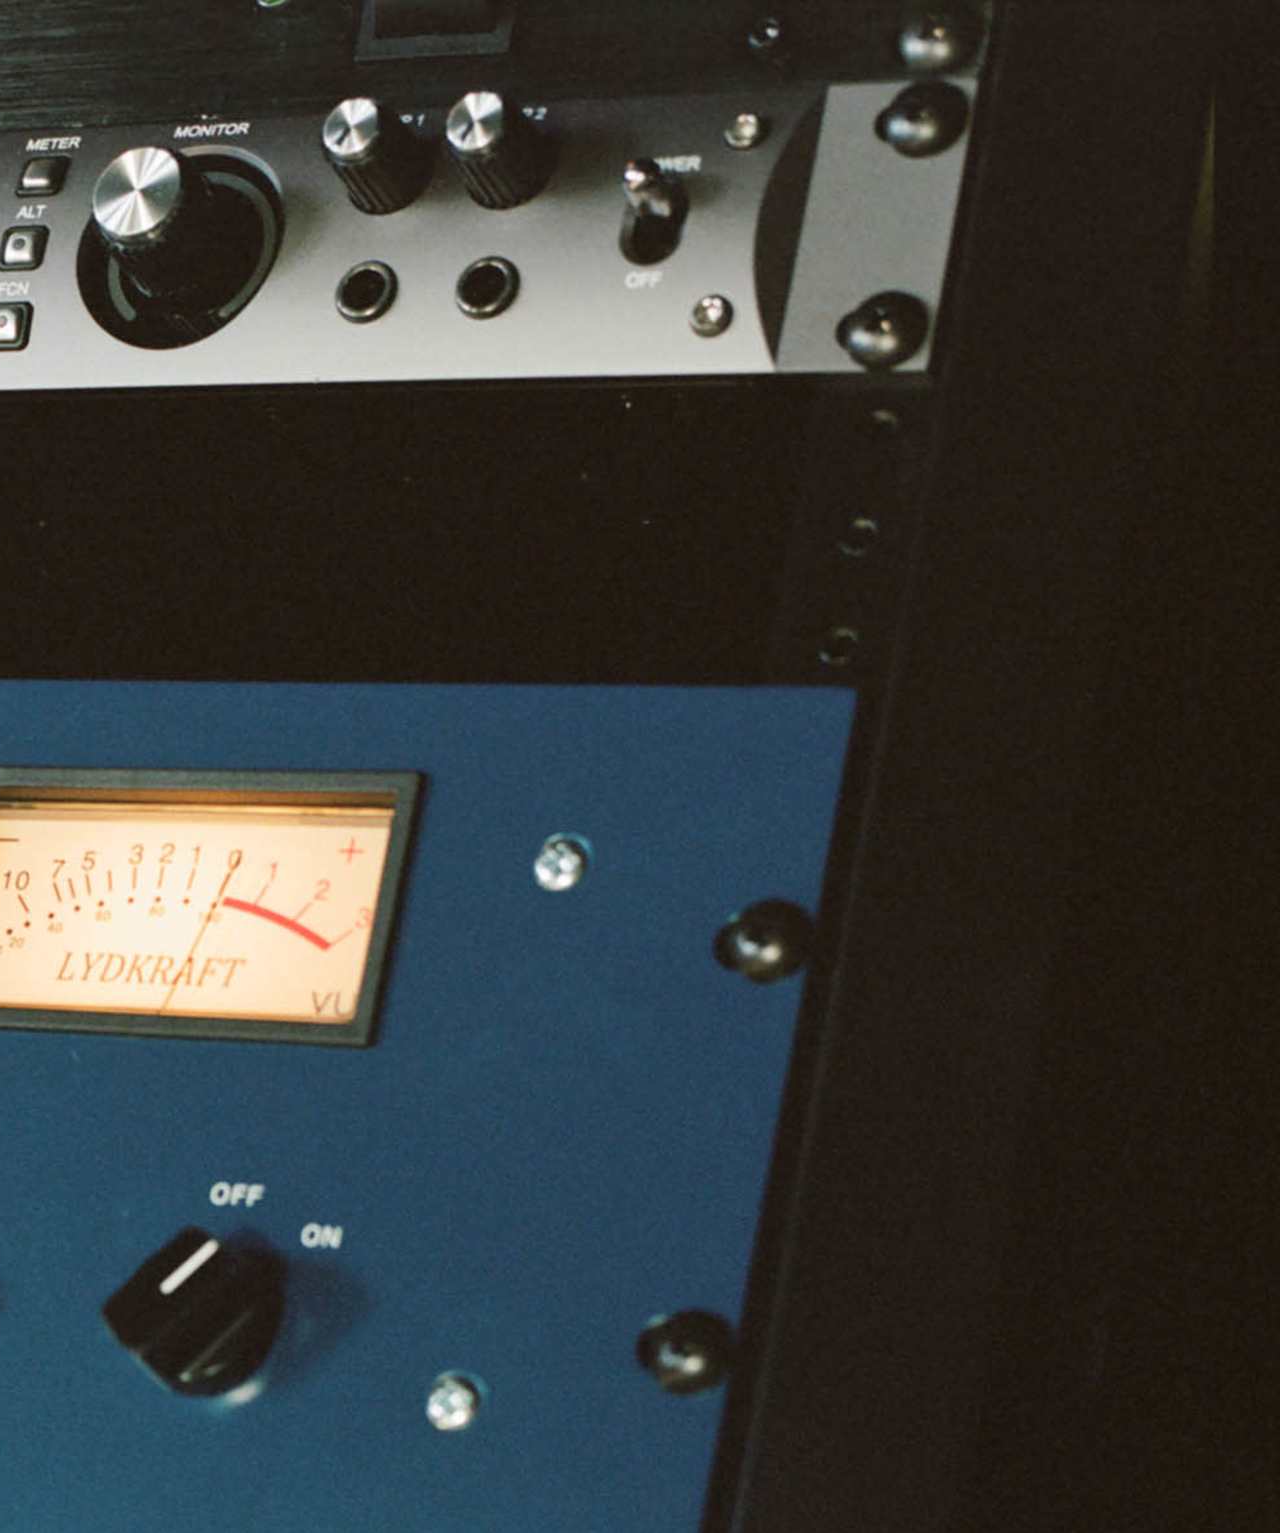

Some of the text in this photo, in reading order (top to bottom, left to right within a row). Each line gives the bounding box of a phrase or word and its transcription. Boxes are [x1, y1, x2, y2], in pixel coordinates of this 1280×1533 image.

[173, 122, 250, 138] MONITOR
[26, 136, 81, 151] METER
[16, 205, 47, 220] ALT
[624, 272, 664, 289] OFF
[2, 843, 176, 890] 10 7 5 3 2
[56, 951, 247, 988] LYDKRAFT
[209, 1181, 265, 1207] OFF
[300, 1222, 344, 1249] ON
